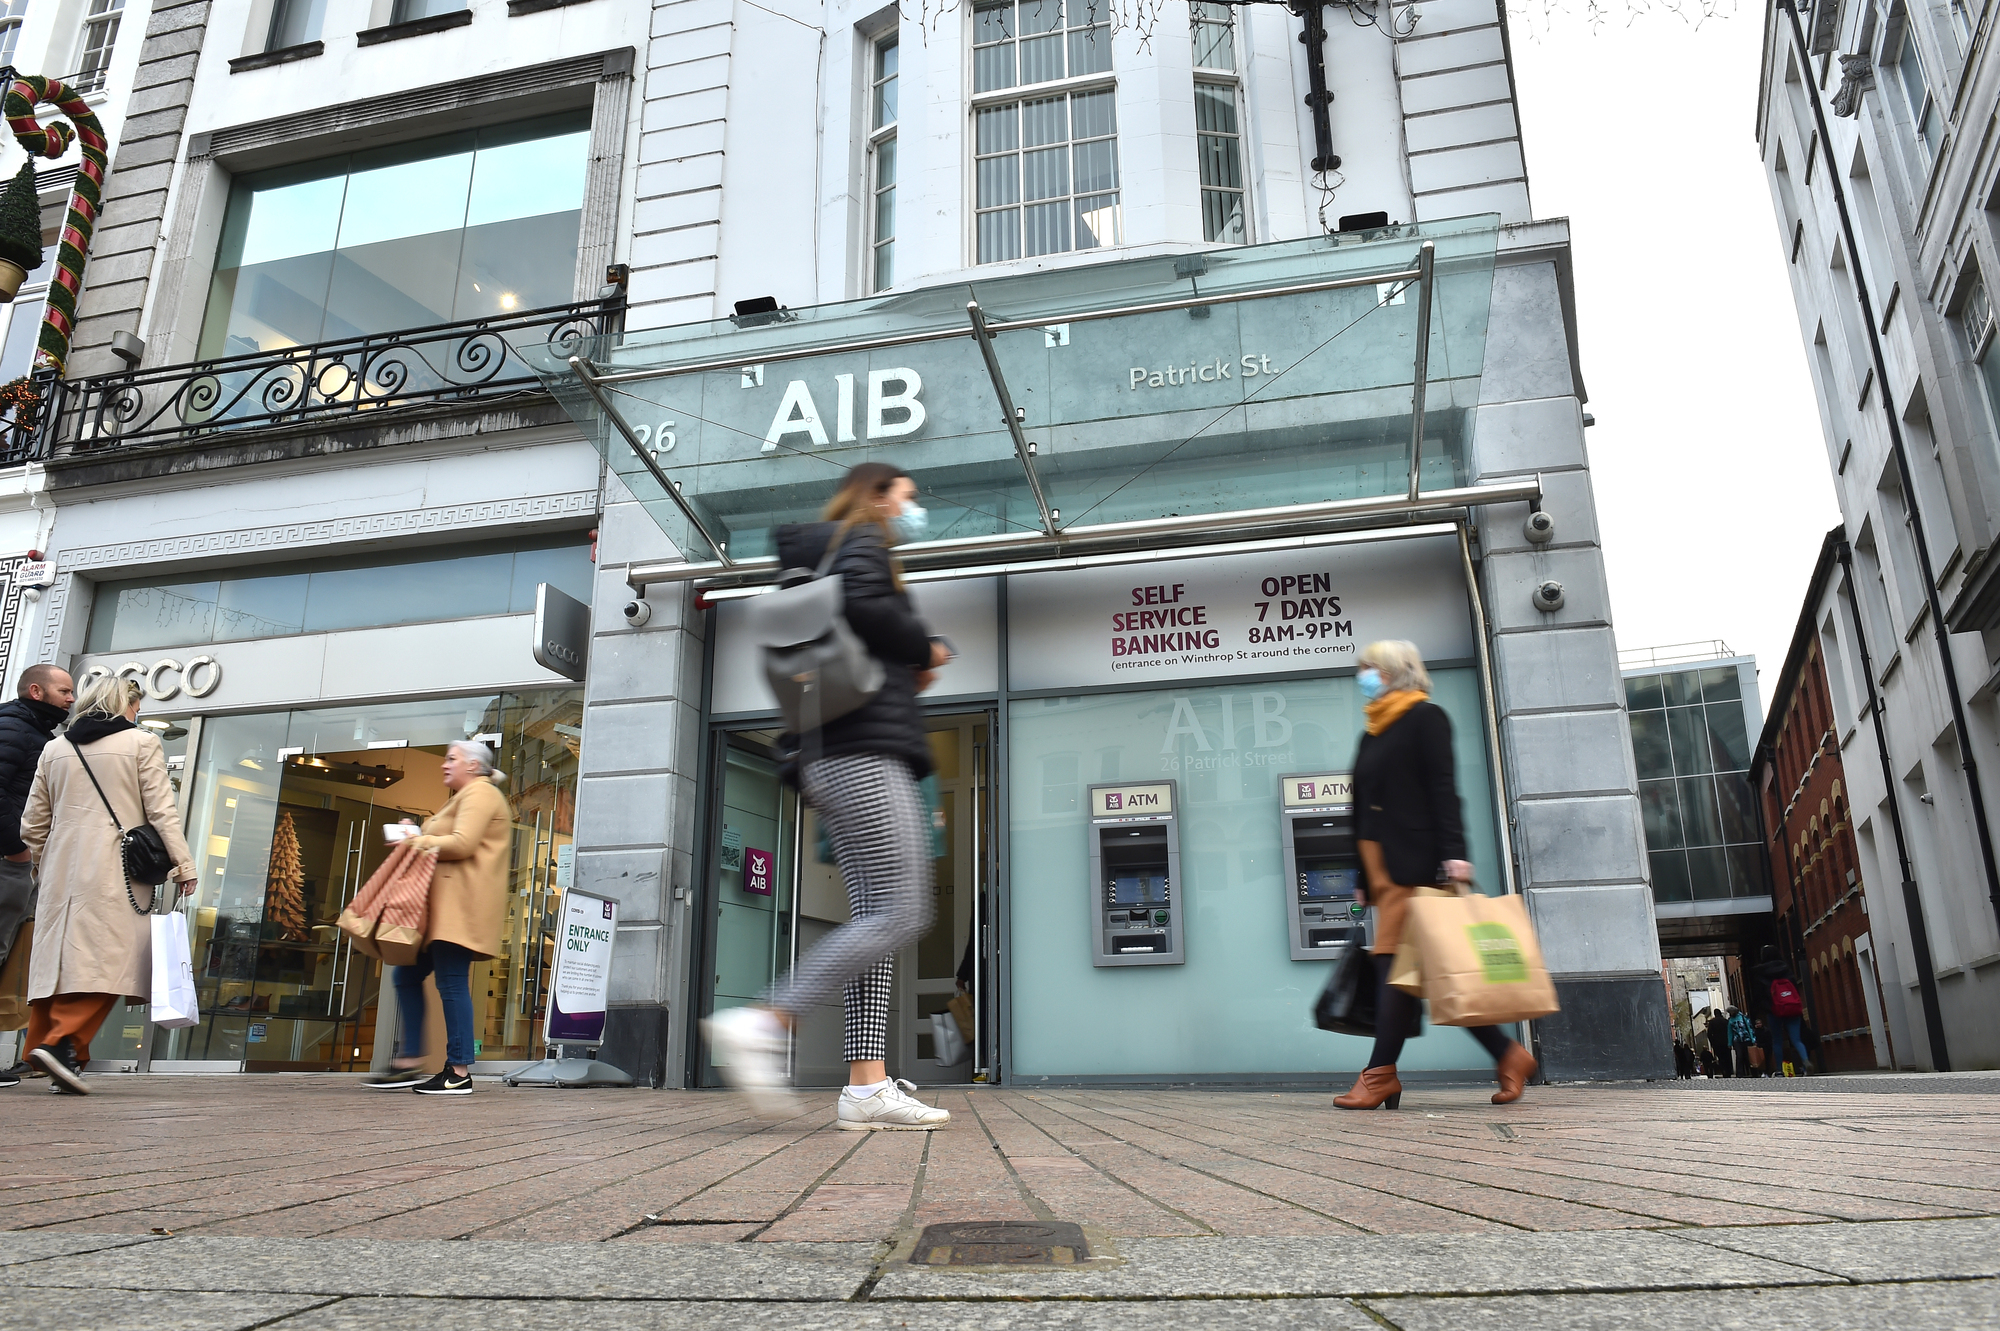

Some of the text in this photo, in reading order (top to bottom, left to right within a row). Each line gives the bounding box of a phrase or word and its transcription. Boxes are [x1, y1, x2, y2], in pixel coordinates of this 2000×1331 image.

[1129, 353, 1280, 391] Patrick St.
[760, 367, 928, 453] AIB
[630, 420, 677, 457] 26
[1131, 583, 1185, 606] SELF
[1261, 572, 1331, 598] OPEN
[1112, 606, 1207, 632] SERVICE
[1254, 596, 1342, 622] 7 DAYS
[1111, 629, 1220, 657] BANKING
[1248, 620, 1353, 644] 8AM-9PM
[547, 640, 579, 667] ecco
[1111, 642, 1356, 672] (entrance on Winthrop St around the corner)
[1159, 691, 1293, 754] AIB
[1160, 750, 1295, 772] 26 Patrick Street
[1128, 793, 1158, 807] ATM
[1321, 783, 1353, 796] ATM
[750, 876, 766, 890] AIB
[567, 938, 590, 952] ONLY
[568, 924, 610, 943] ENTRANCE
